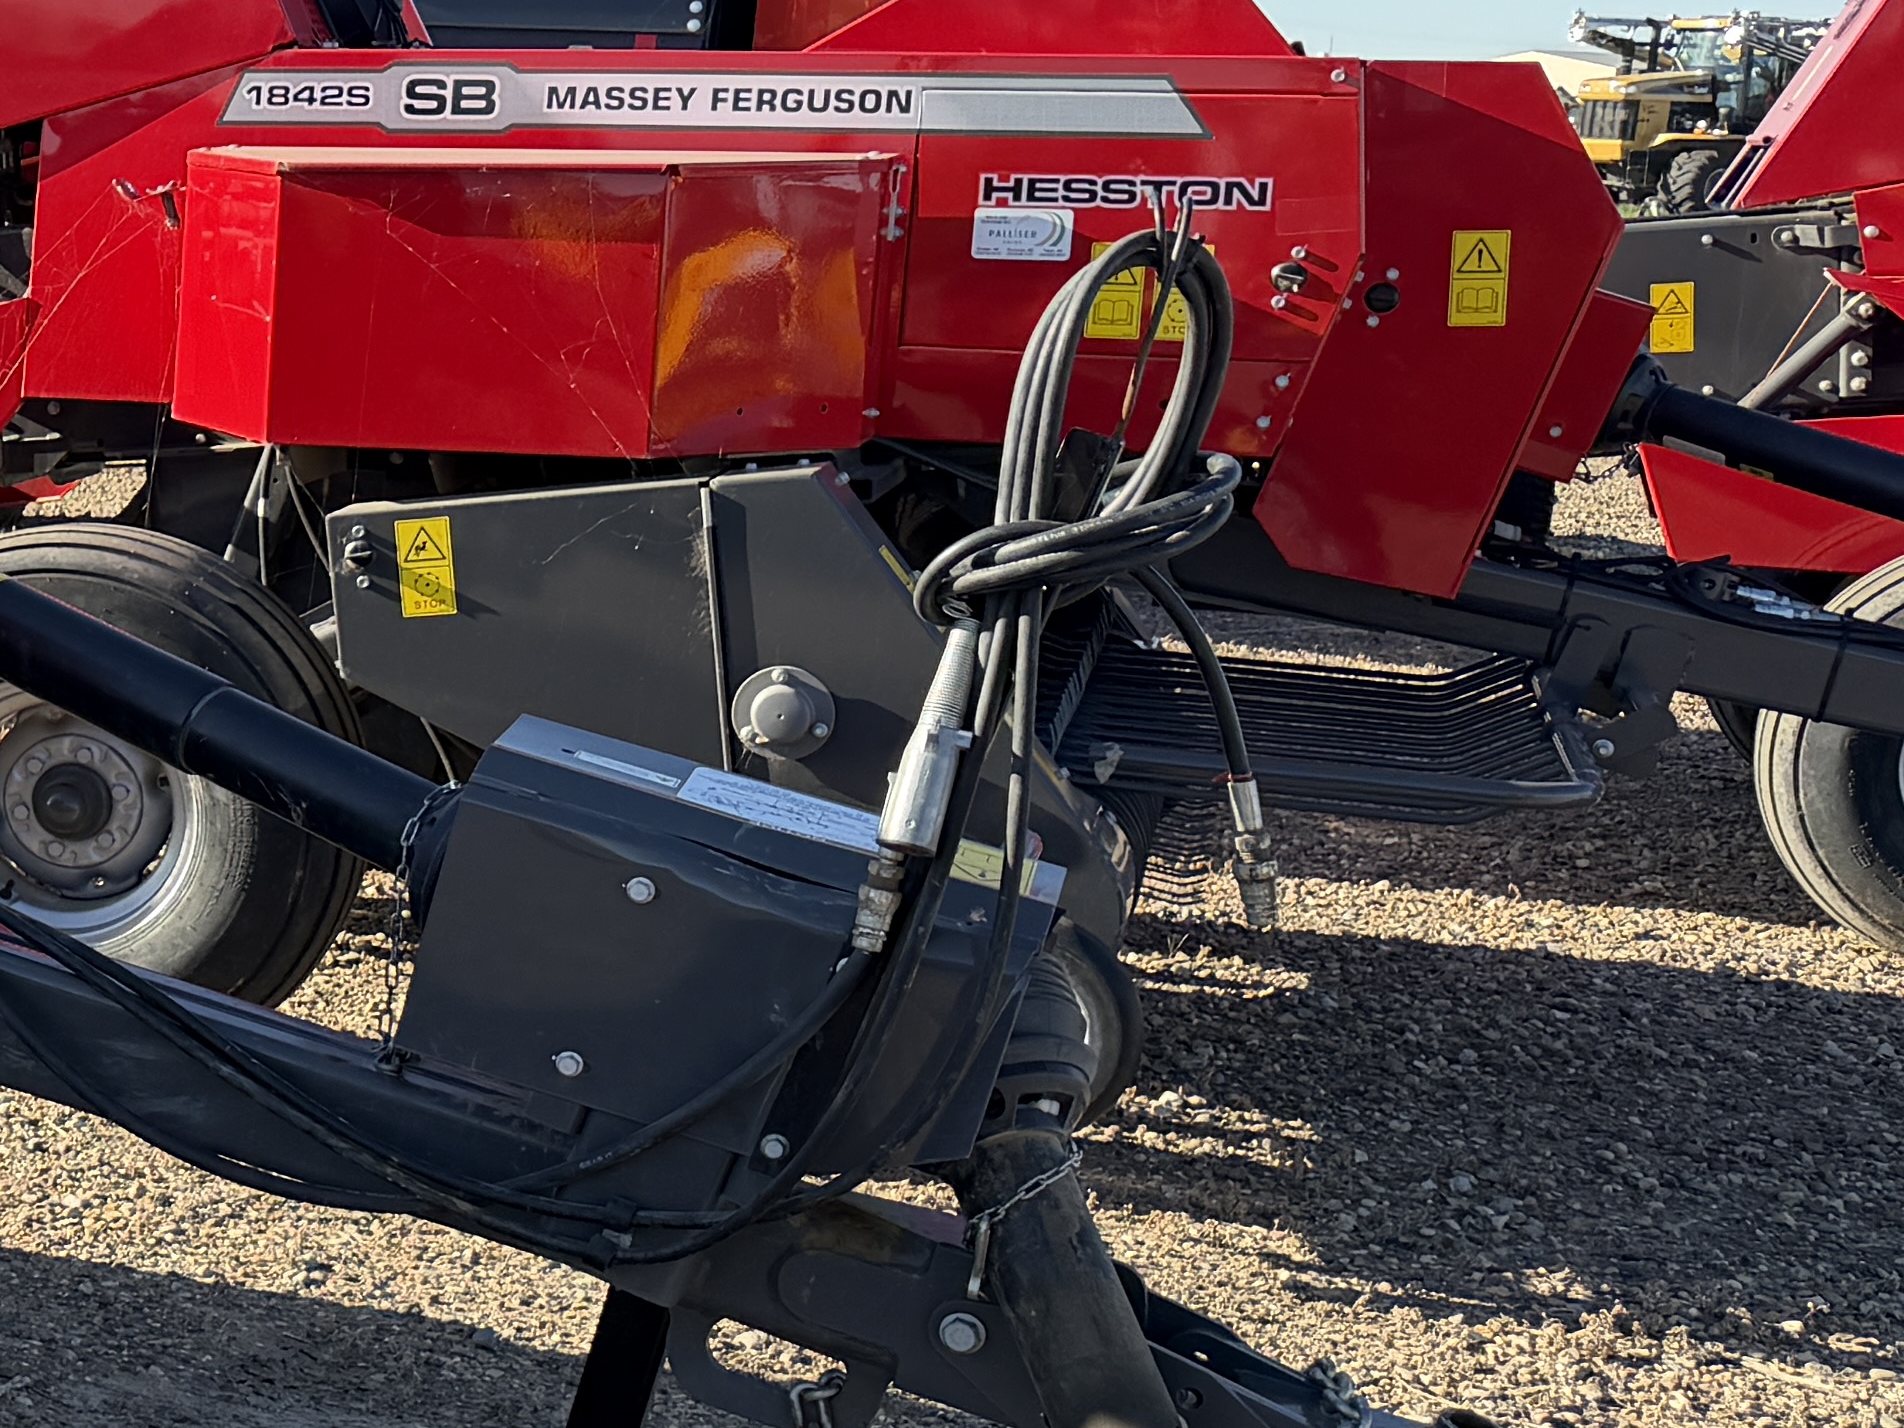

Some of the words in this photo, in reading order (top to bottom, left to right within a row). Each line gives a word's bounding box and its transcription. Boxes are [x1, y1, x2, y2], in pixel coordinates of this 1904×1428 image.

[244, 83, 372, 109] 1842S
[403, 77, 498, 116] SB
[546, 85, 697, 112] MASSEY
[709, 88, 914, 115] FERGUSON
[981, 175, 1271, 209] HESSTON
[988, 227, 1038, 239] PALLISER
[413, 598, 448, 610] STOP
